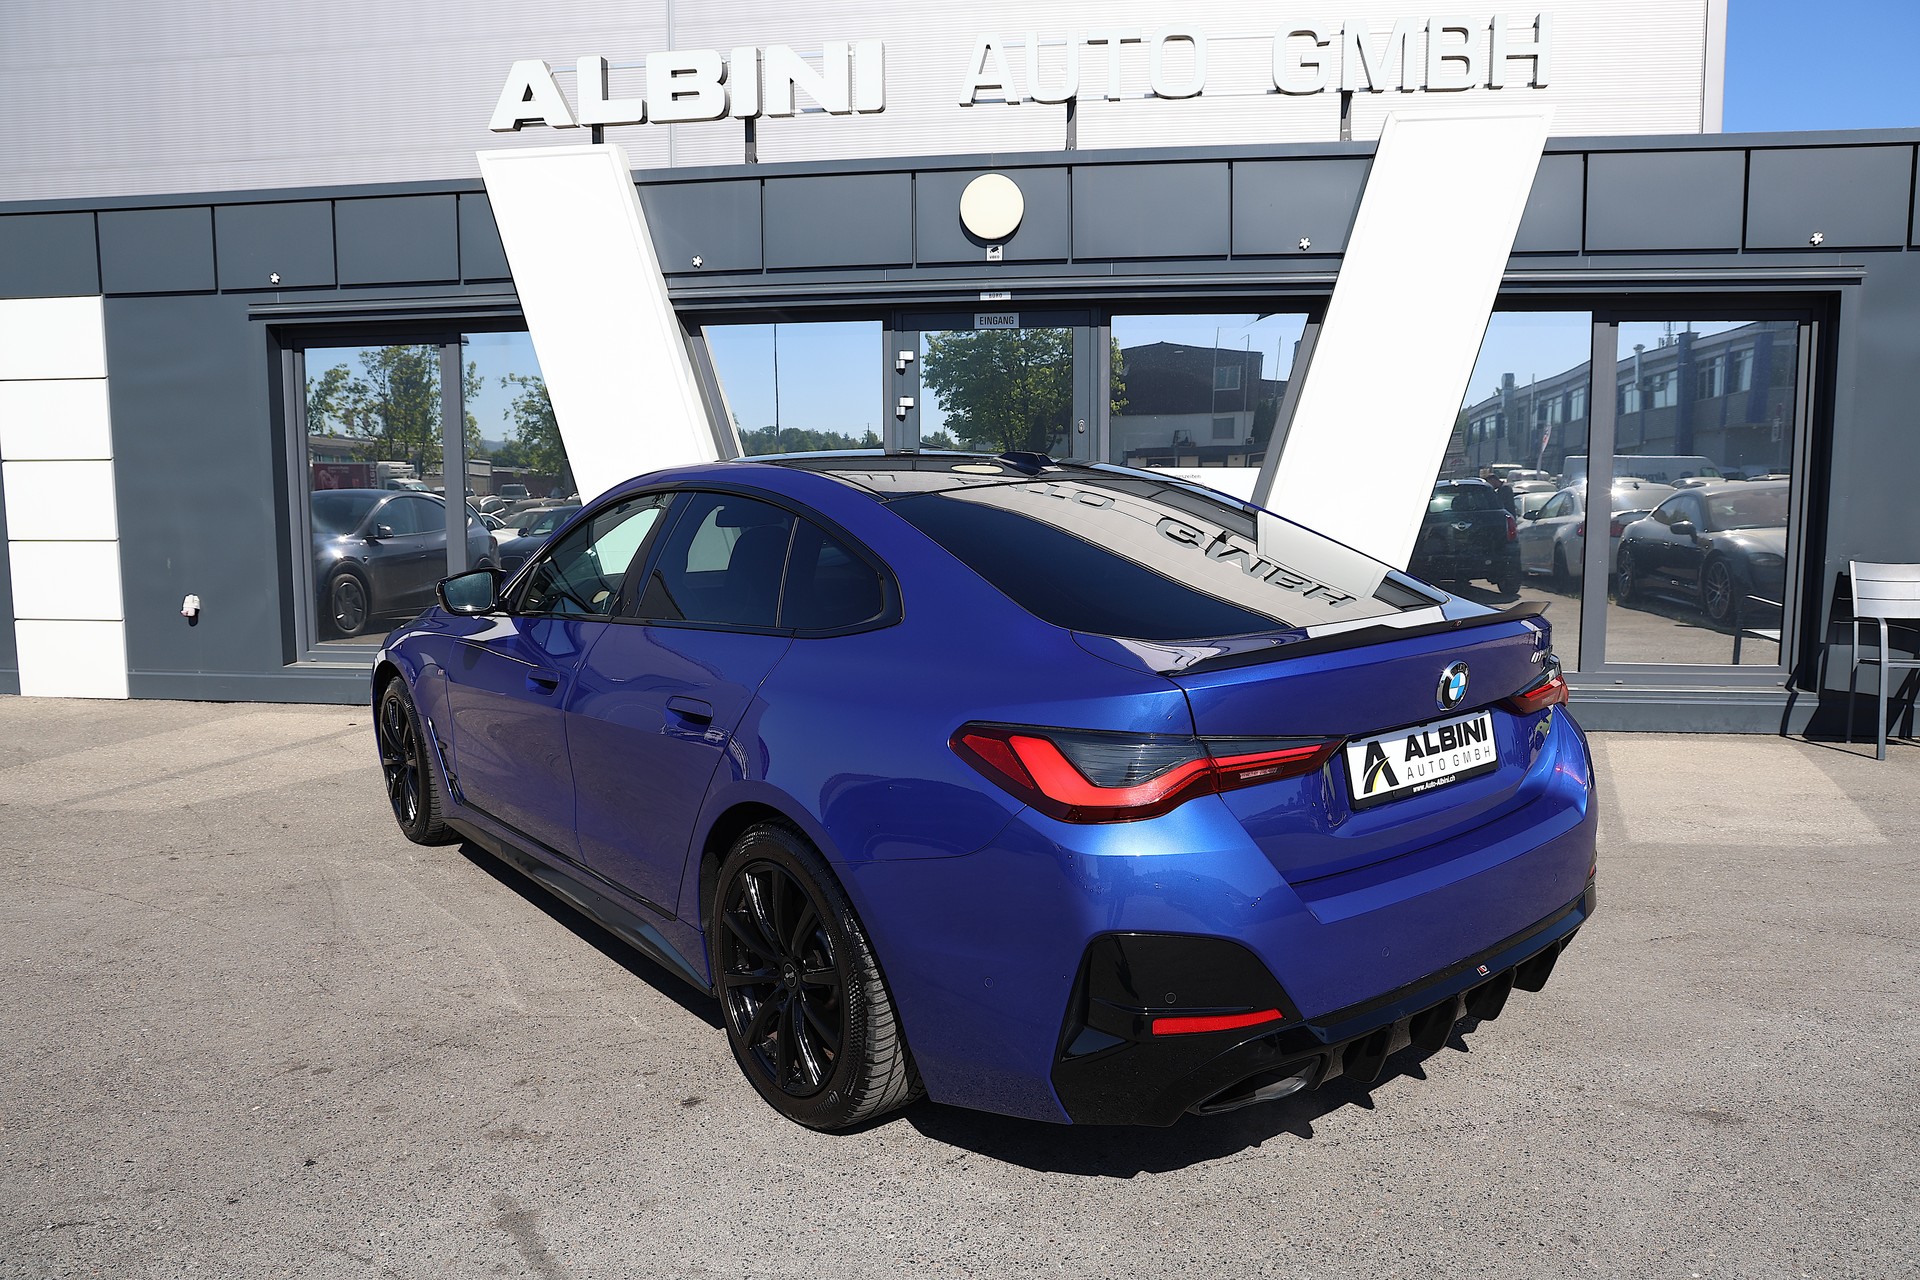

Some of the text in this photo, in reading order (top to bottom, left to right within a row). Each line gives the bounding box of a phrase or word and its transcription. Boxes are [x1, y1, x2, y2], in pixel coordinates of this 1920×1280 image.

[489, 12, 1553, 133] ALBINI AUTO GMBH
[979, 316, 1014, 325] EINGANG
[1404, 717, 1488, 762] ALBINI
[1407, 745, 1491, 780] AUTO GMBH
[1412, 774, 1456, 793] www.Auto-Albini.ch
